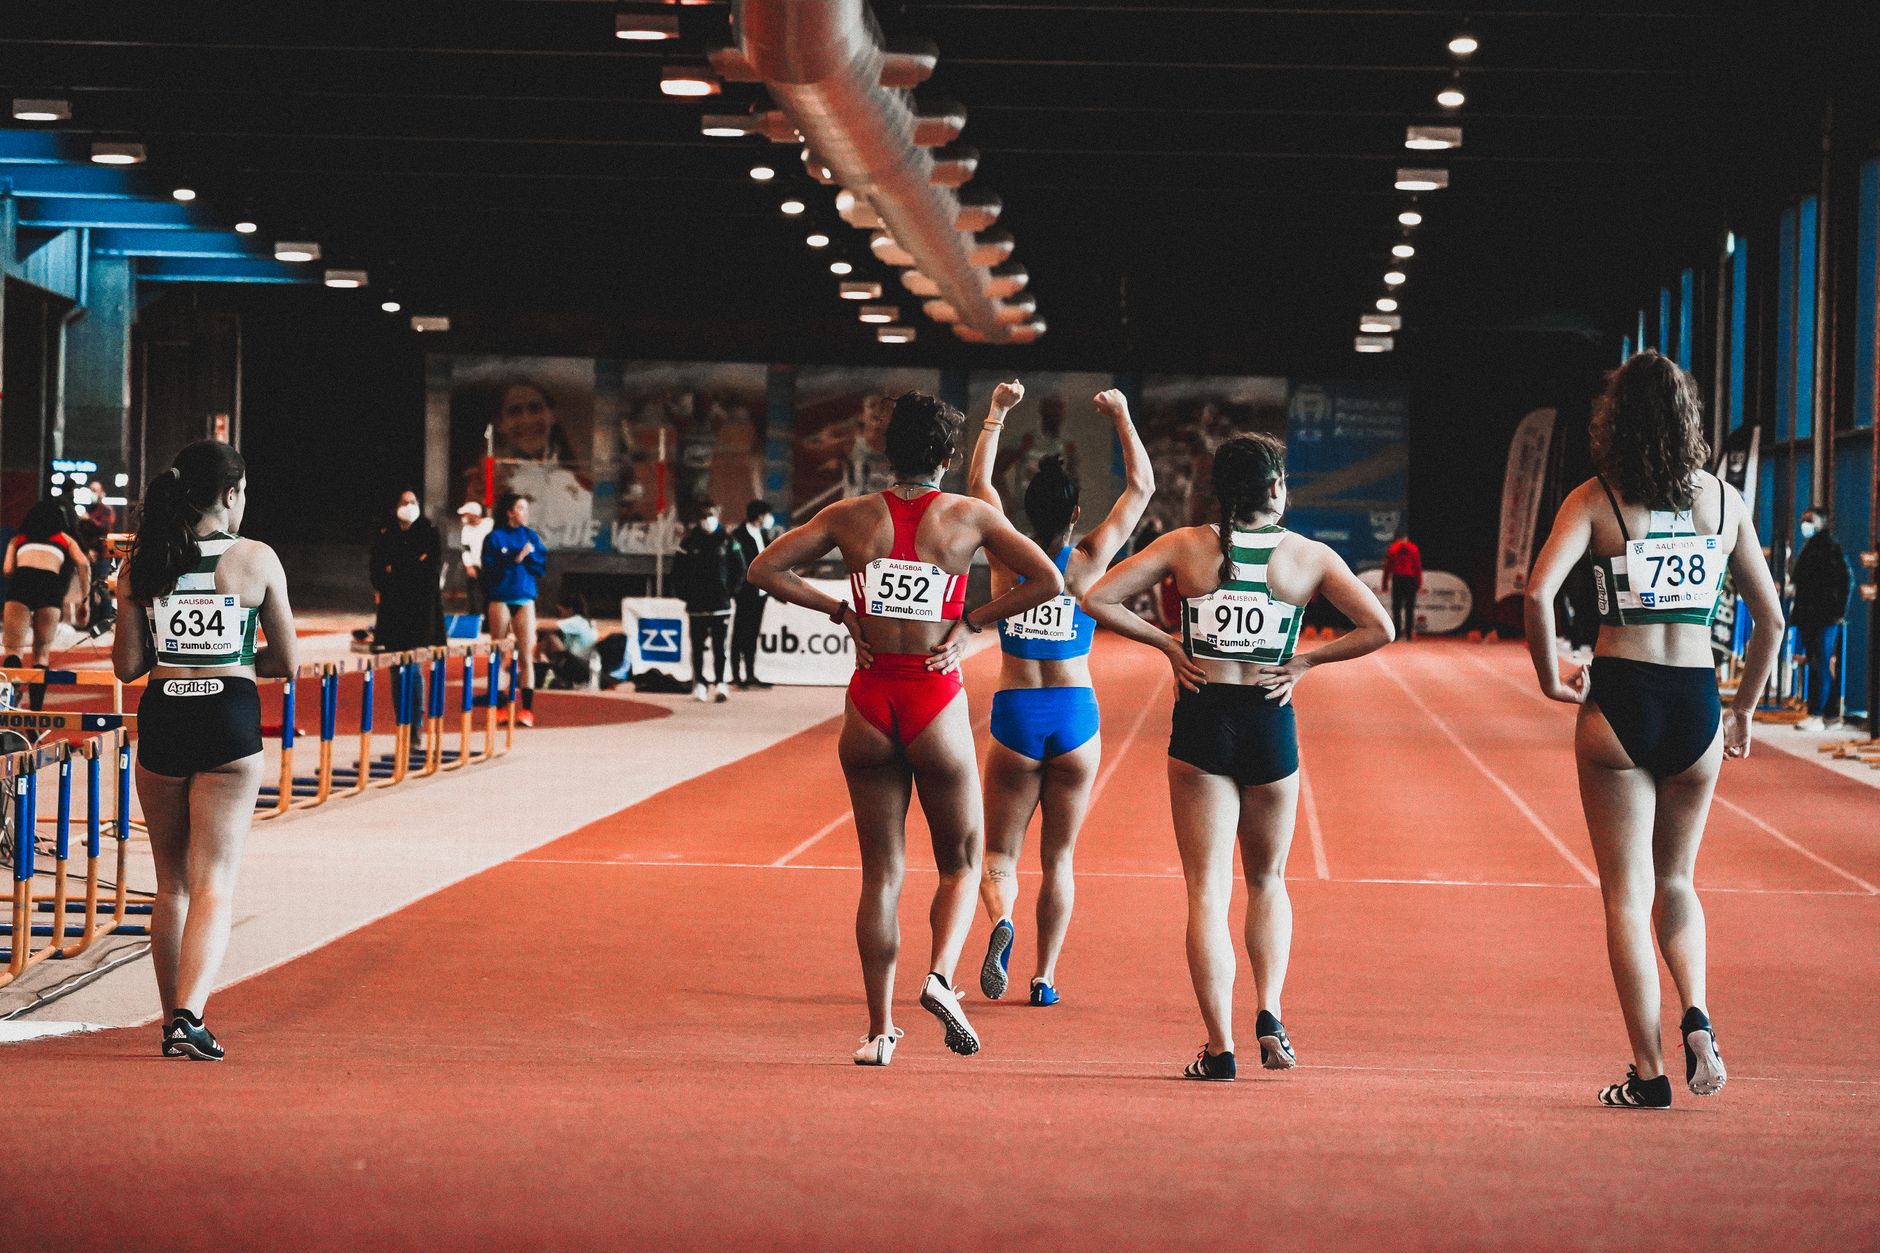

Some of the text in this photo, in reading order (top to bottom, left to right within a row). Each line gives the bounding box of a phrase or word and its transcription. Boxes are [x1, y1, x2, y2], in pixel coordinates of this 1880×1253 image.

[889, 563, 922, 572] AALISBOA
[1646, 554, 1706, 589] 738
[877, 572, 930, 603] 552
[884, 605, 933, 616] zumub.com
[170, 609, 225, 637] 634
[1214, 604, 1264, 634] 910
[1024, 627, 1065, 637] zumub.com
[180, 641, 232, 650] zumub.com
[758, 625, 853, 654] ub.co
[1219, 638, 1266, 648] zumub.cm
[168, 681, 219, 695] Agriloja
